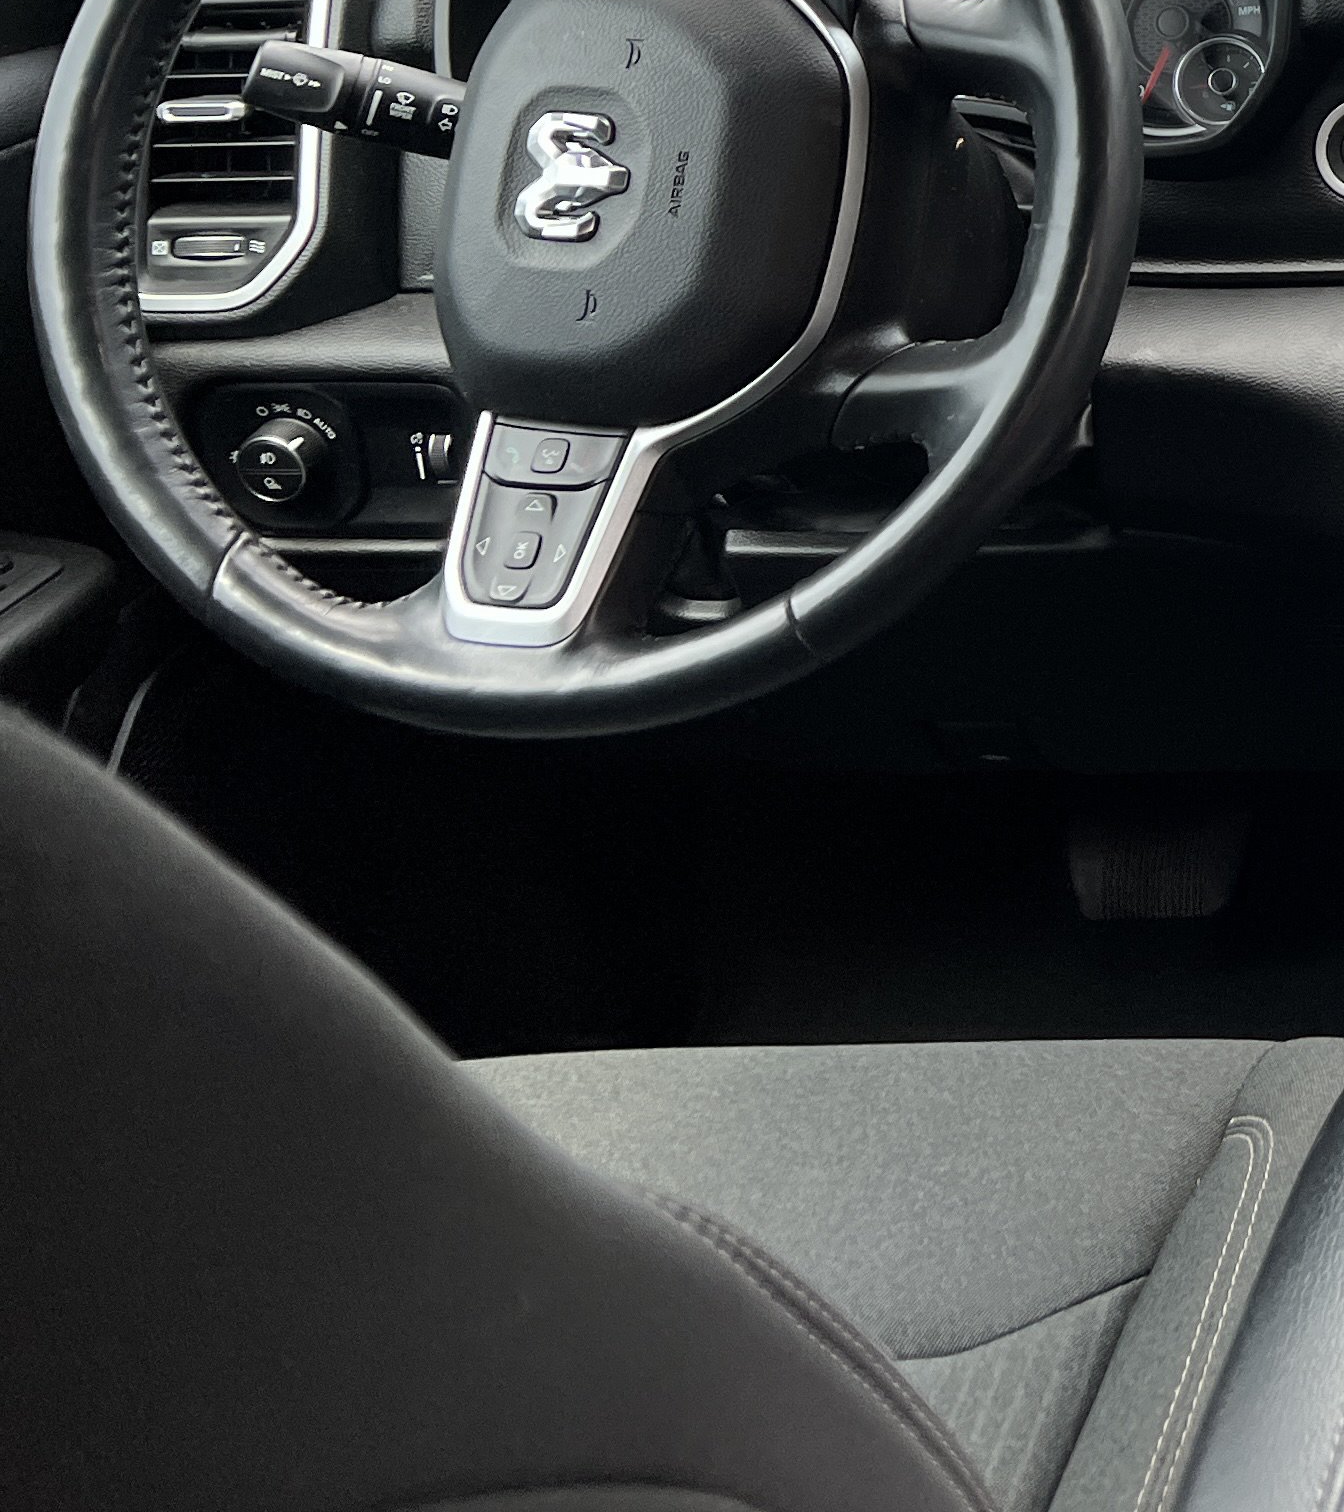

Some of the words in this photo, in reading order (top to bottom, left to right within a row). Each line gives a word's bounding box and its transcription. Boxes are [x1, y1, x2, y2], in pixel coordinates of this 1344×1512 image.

[1238, 6, 1261, 16] MPH
[668, 150, 690, 218] AIRBAG
[313, 417, 337, 440] AUTO
[513, 540, 529, 560] OK
